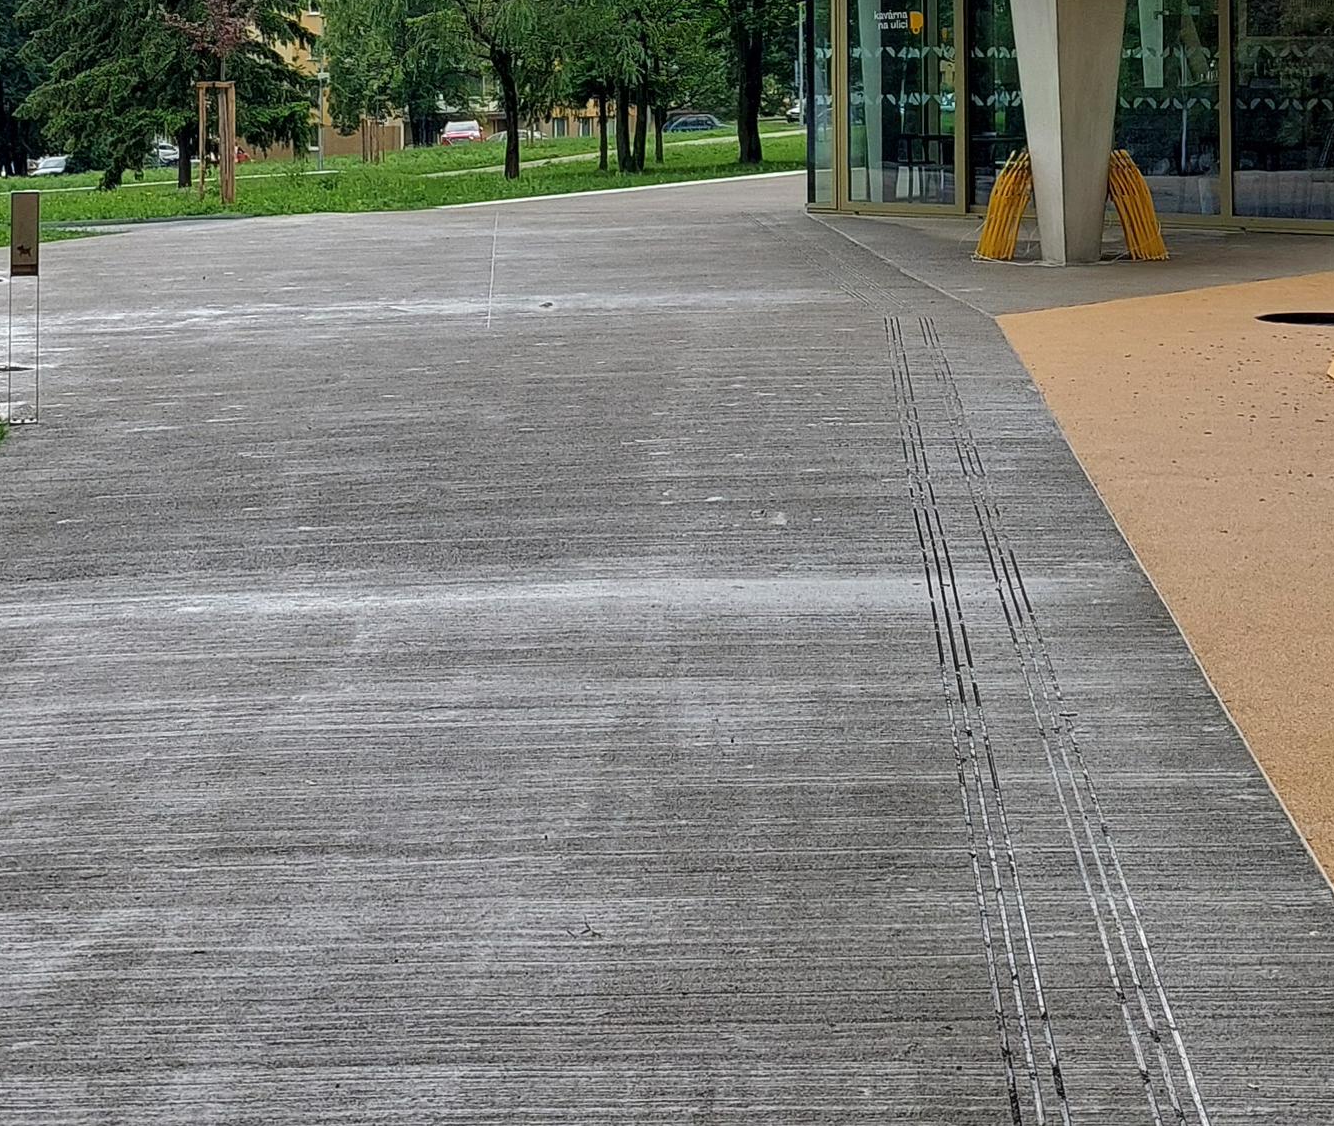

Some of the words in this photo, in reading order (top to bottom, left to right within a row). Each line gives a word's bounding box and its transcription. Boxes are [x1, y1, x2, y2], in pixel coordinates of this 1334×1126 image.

[874, 9, 908, 20] kavárna
[878, 21, 889, 30] na
[890, 19, 908, 29] ulici
